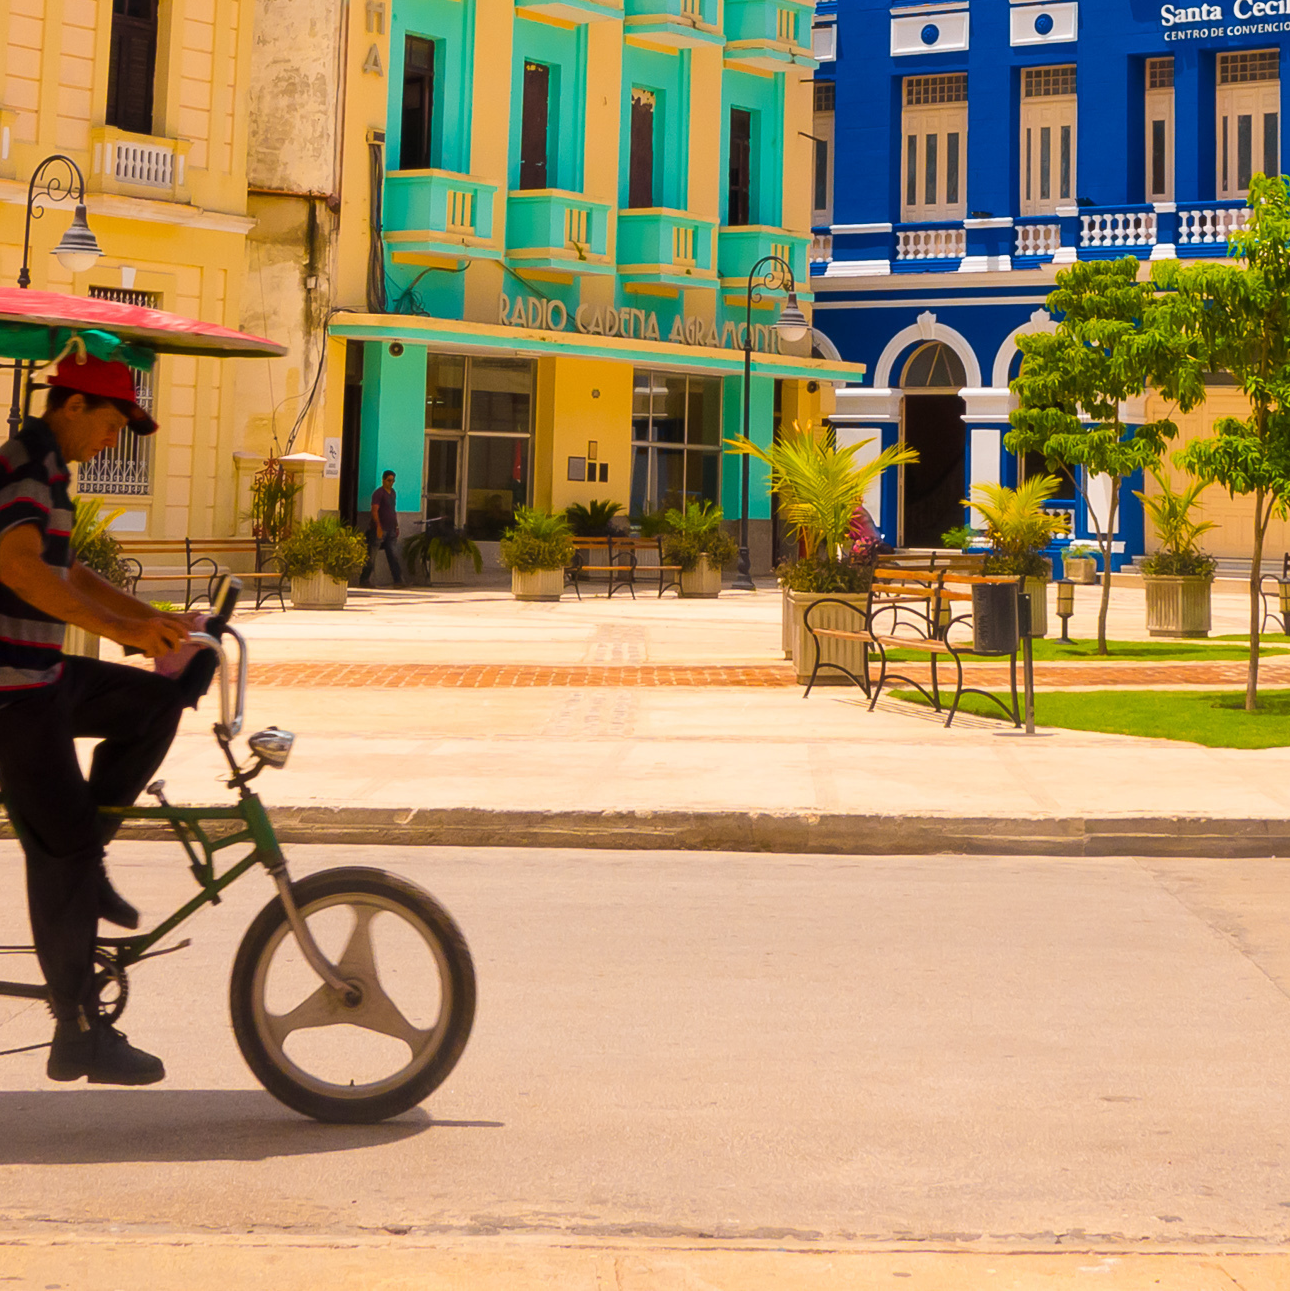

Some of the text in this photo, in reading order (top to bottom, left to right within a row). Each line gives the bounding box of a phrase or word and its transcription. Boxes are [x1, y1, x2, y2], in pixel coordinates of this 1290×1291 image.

[1161, 3, 1222, 27] Santa
[1164, 27, 1208, 41] CENTRO
[1211, 27, 1224, 37] DE
[499, 292, 567, 331] RADIO
[575, 303, 660, 341] CADENA
